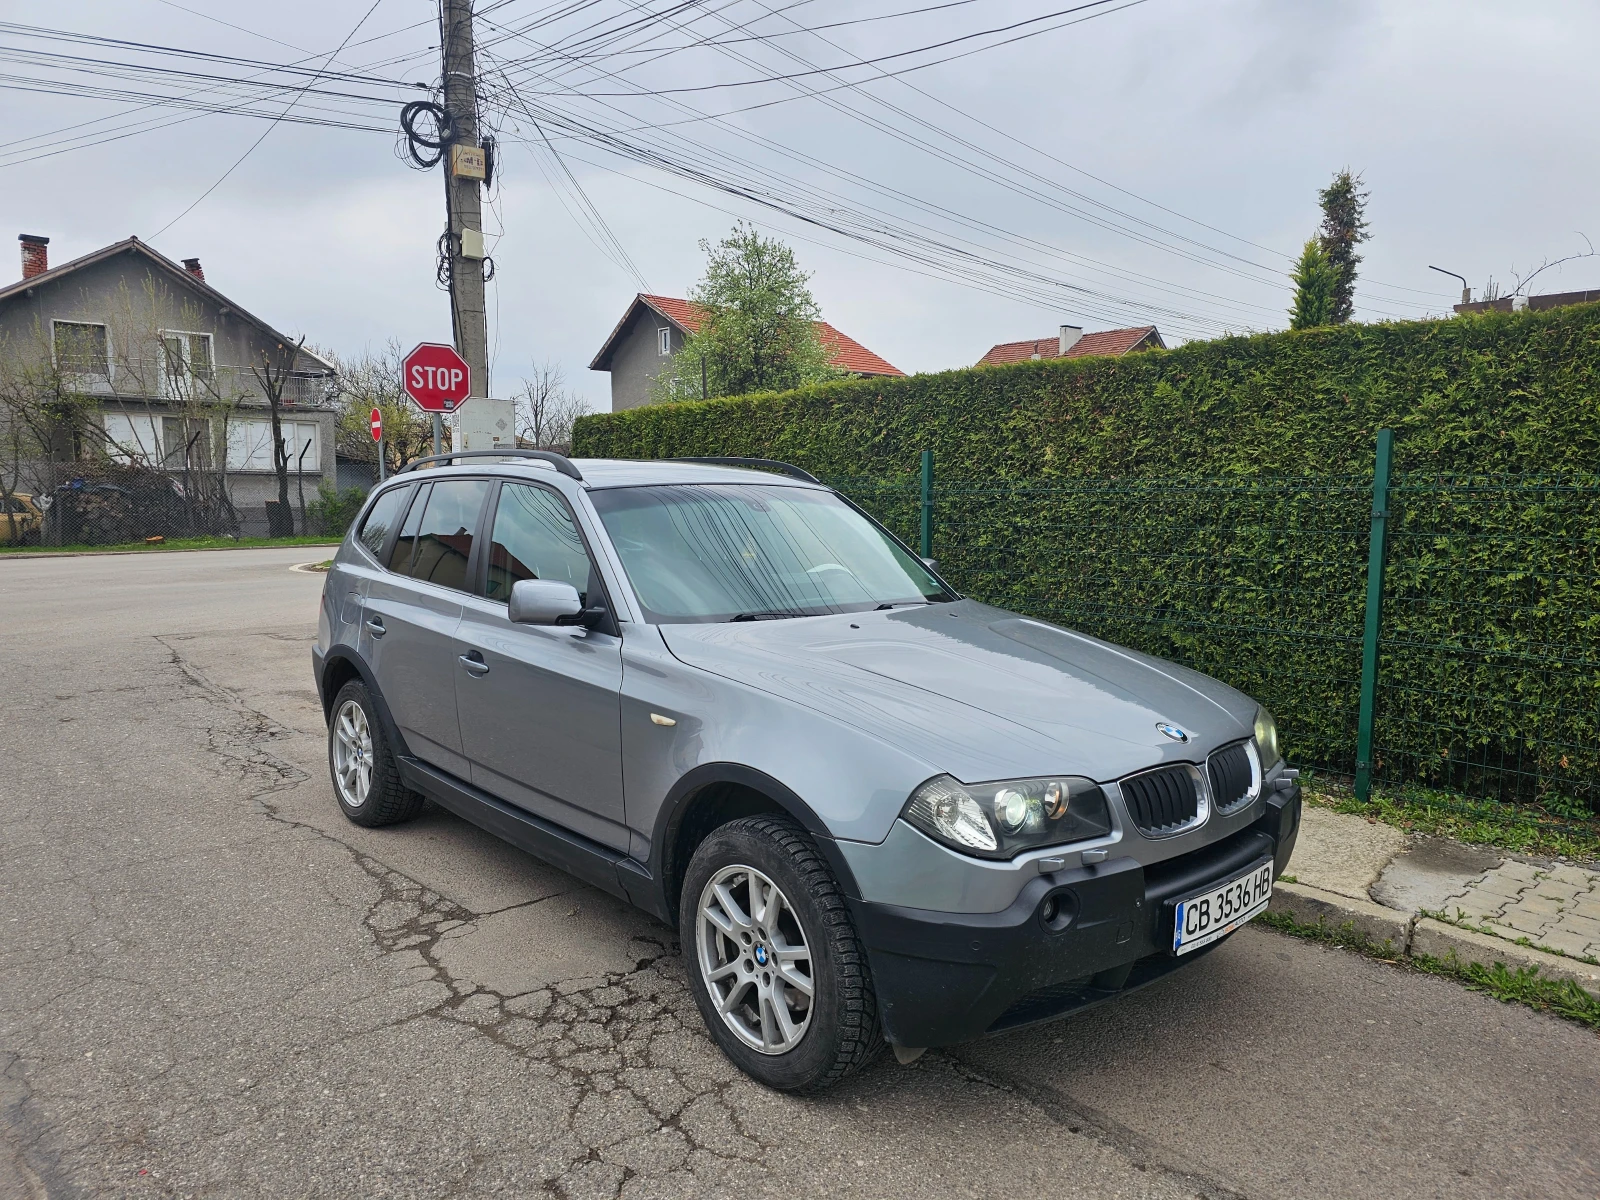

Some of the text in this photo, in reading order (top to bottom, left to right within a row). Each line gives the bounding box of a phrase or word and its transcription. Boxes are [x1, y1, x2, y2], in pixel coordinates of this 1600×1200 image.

[411, 365, 463, 391] STOP
[1186, 899, 1210, 935] CB
[1214, 878, 1250, 923] 3536
[1253, 867, 1270, 902] HB
